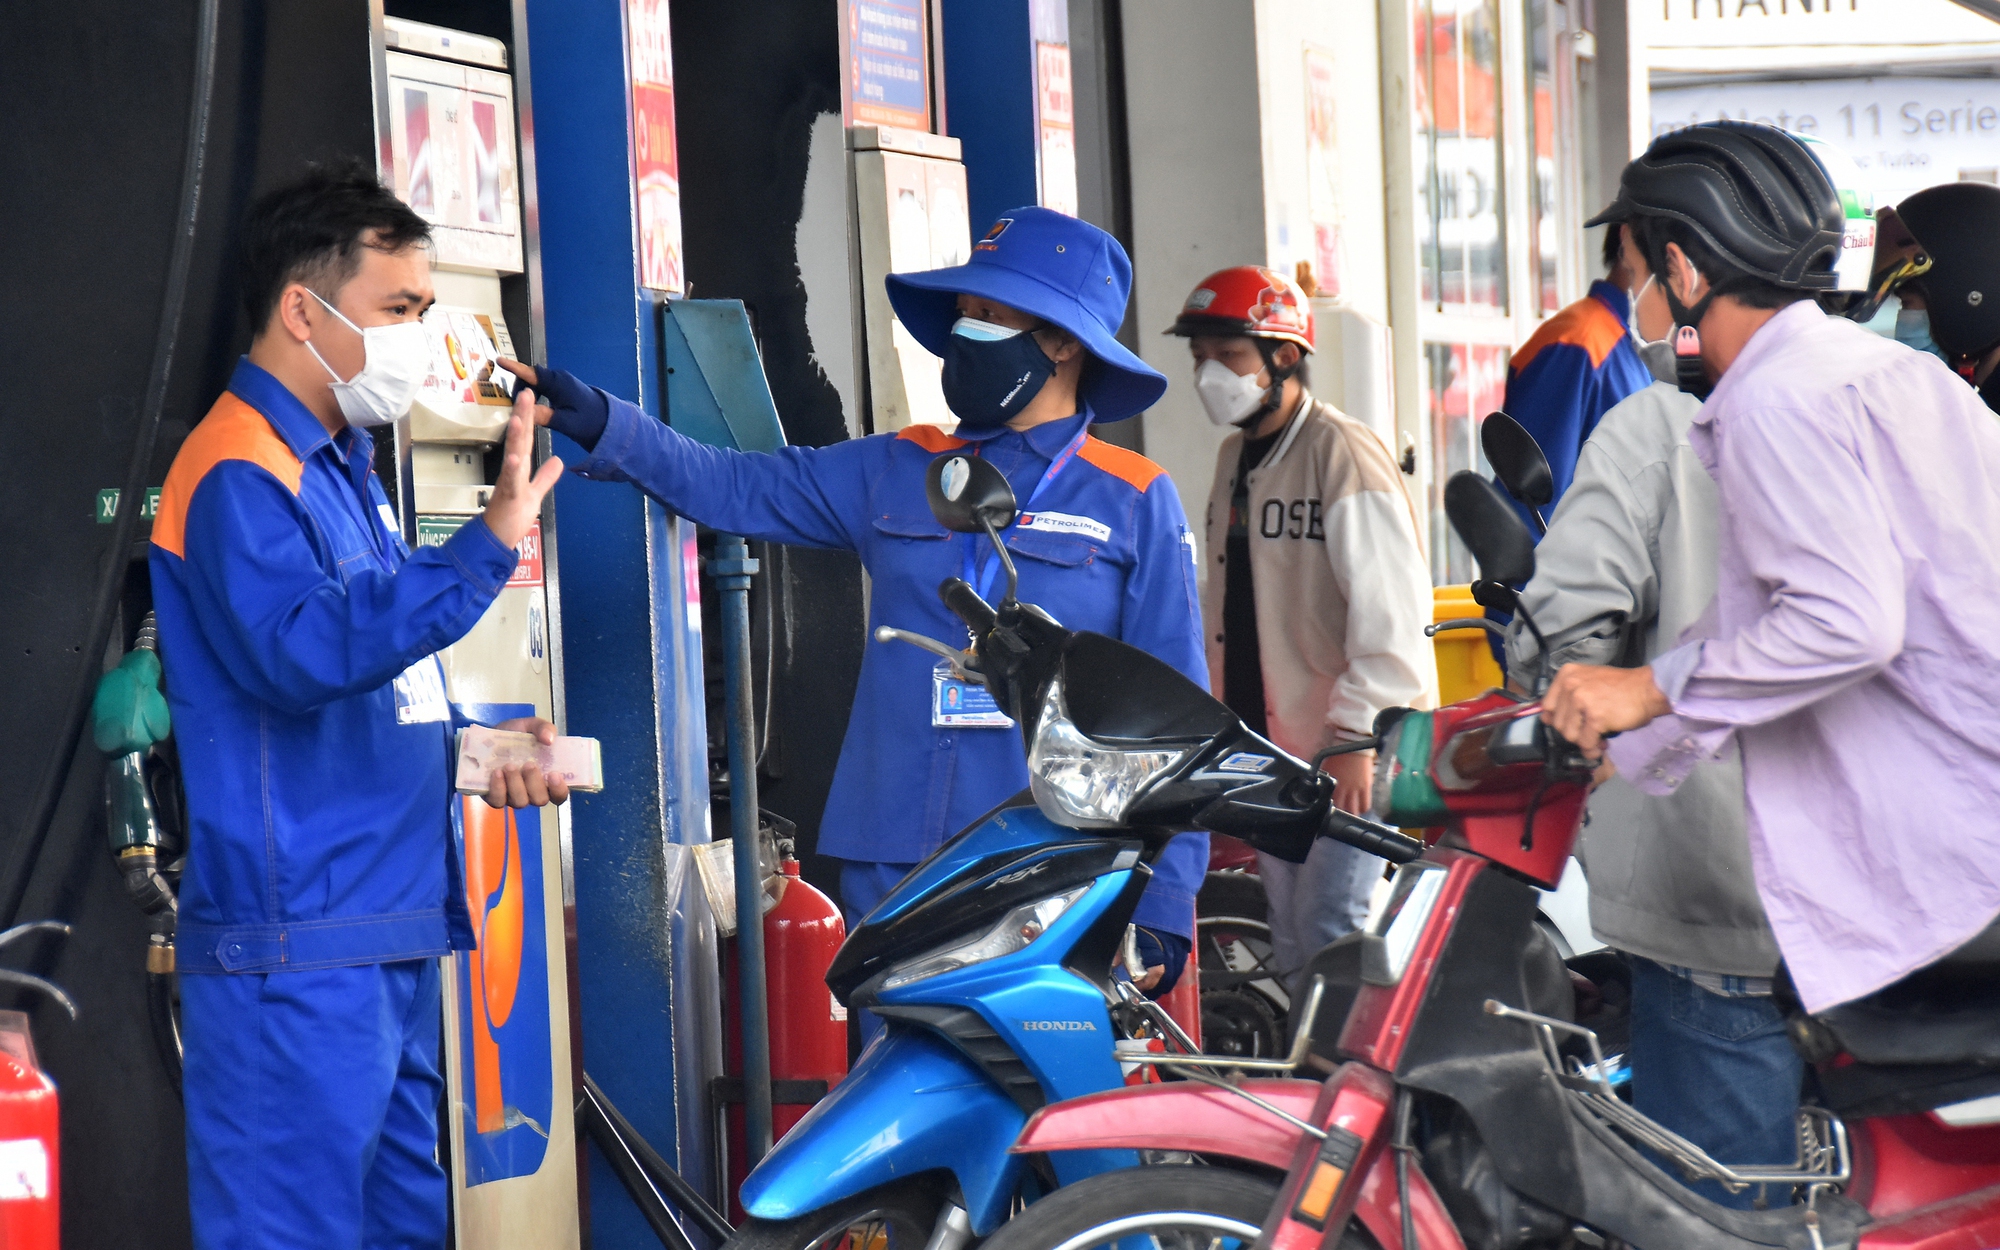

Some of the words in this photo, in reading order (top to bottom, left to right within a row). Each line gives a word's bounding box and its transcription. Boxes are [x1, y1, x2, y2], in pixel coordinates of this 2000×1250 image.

[1838, 103, 1882, 138] 11
[1036, 516, 1106, 535] PETROLIMEX
[529, 607, 543, 659] 03
[1022, 1020, 1098, 1031] HONDA
